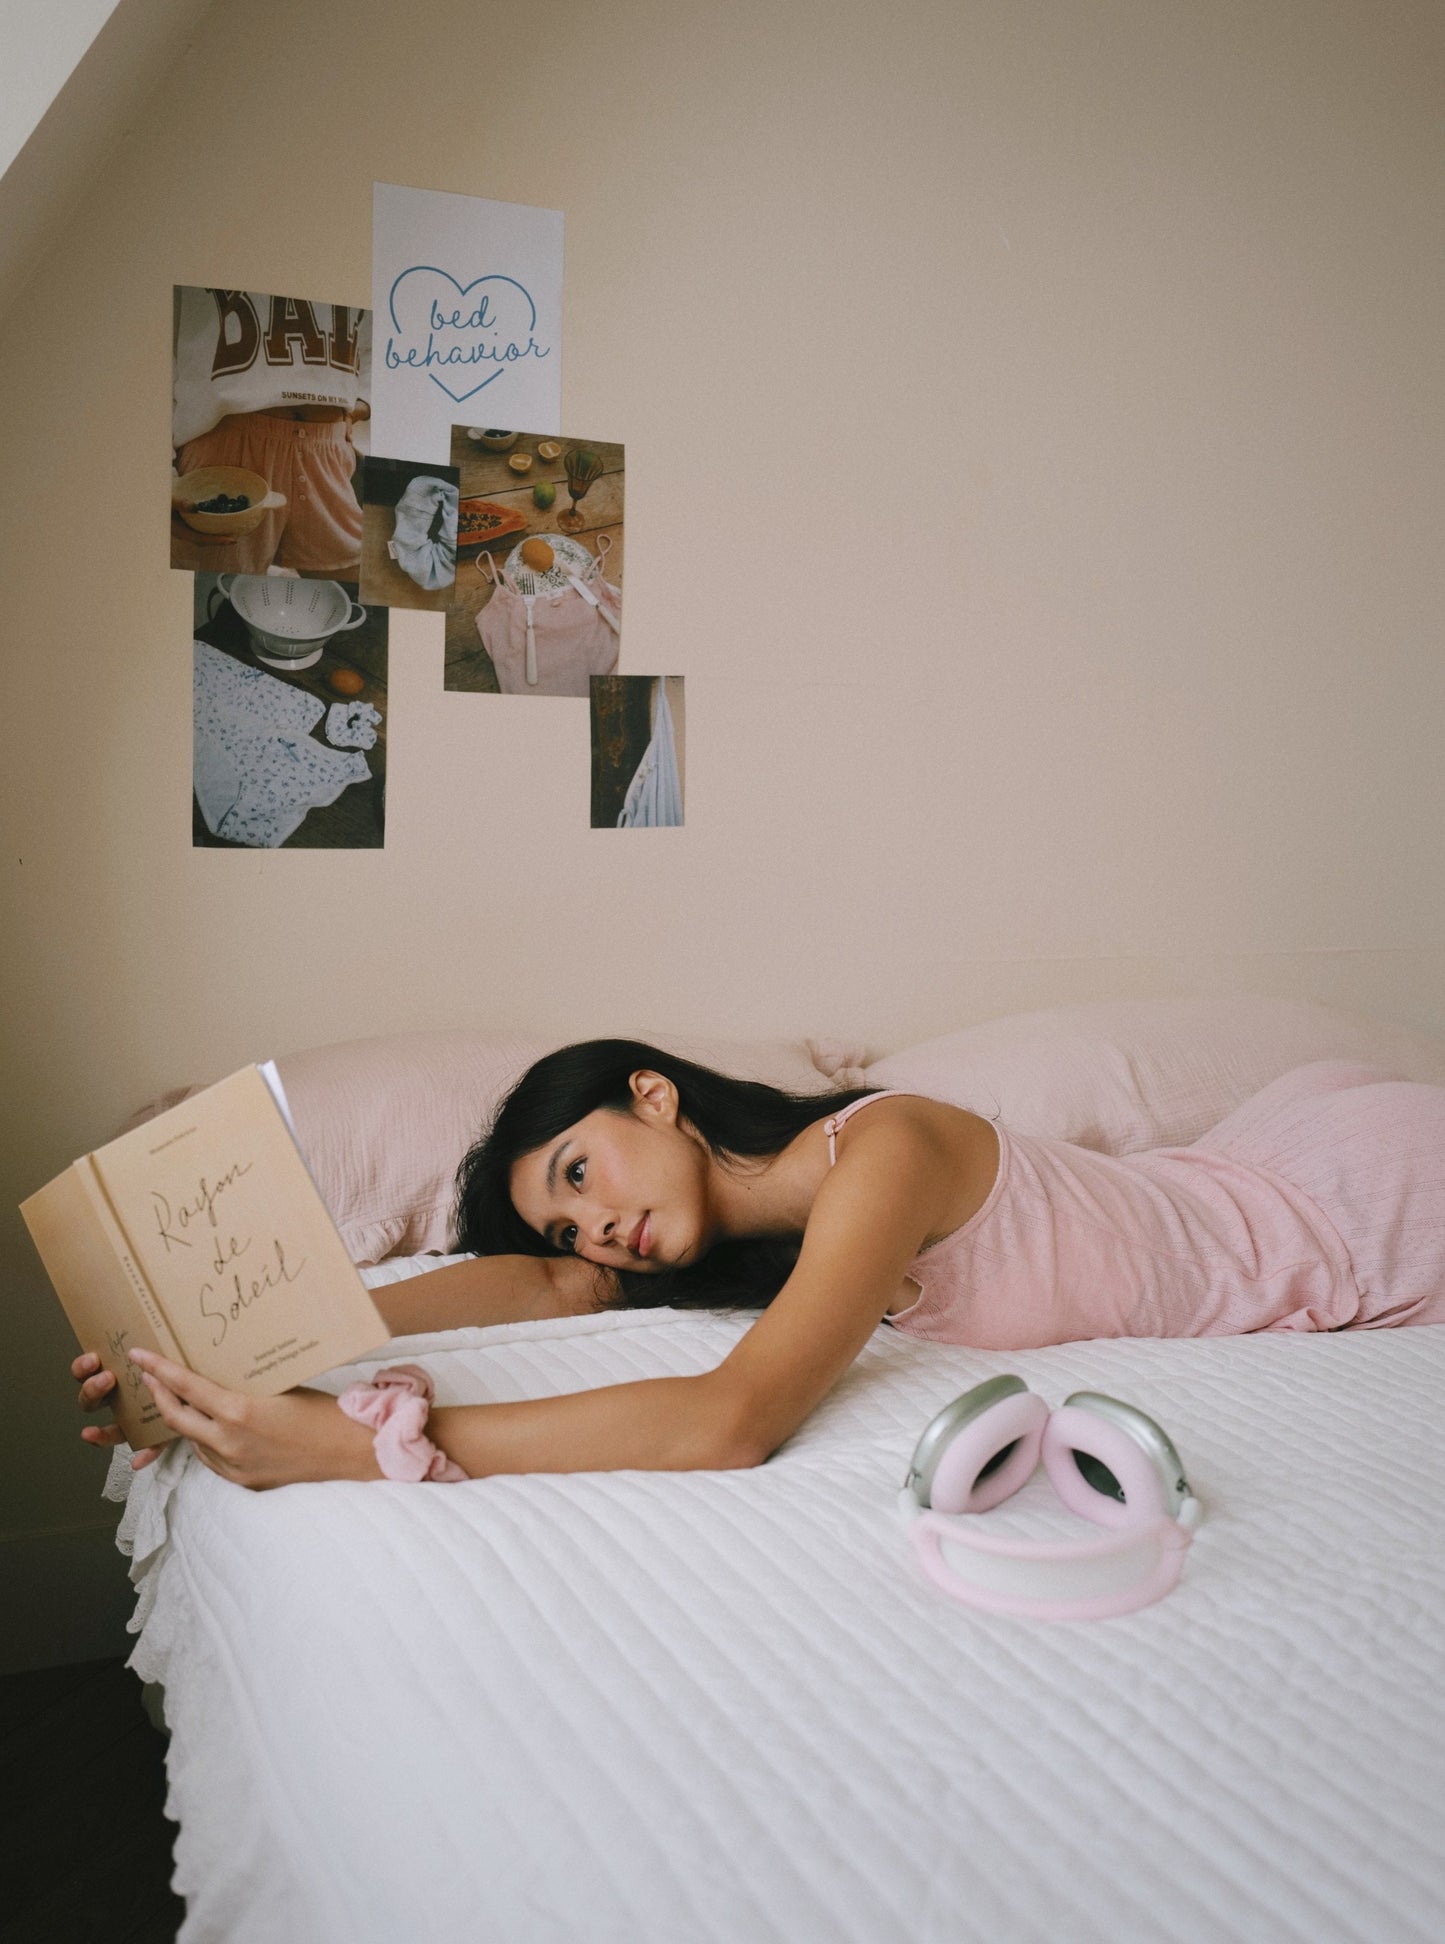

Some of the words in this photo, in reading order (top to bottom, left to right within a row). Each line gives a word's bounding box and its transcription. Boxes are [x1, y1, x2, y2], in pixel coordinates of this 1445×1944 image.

[430, 295, 497, 331] bed
[385, 332, 551, 370] behavior
[281, 391, 316, 401] SUNSETS
[317, 394, 327, 402] ON
[151, 1162, 253, 1252] Rayon
[213, 1235, 251, 1276] de
[200, 1239, 307, 1347] Soleil
